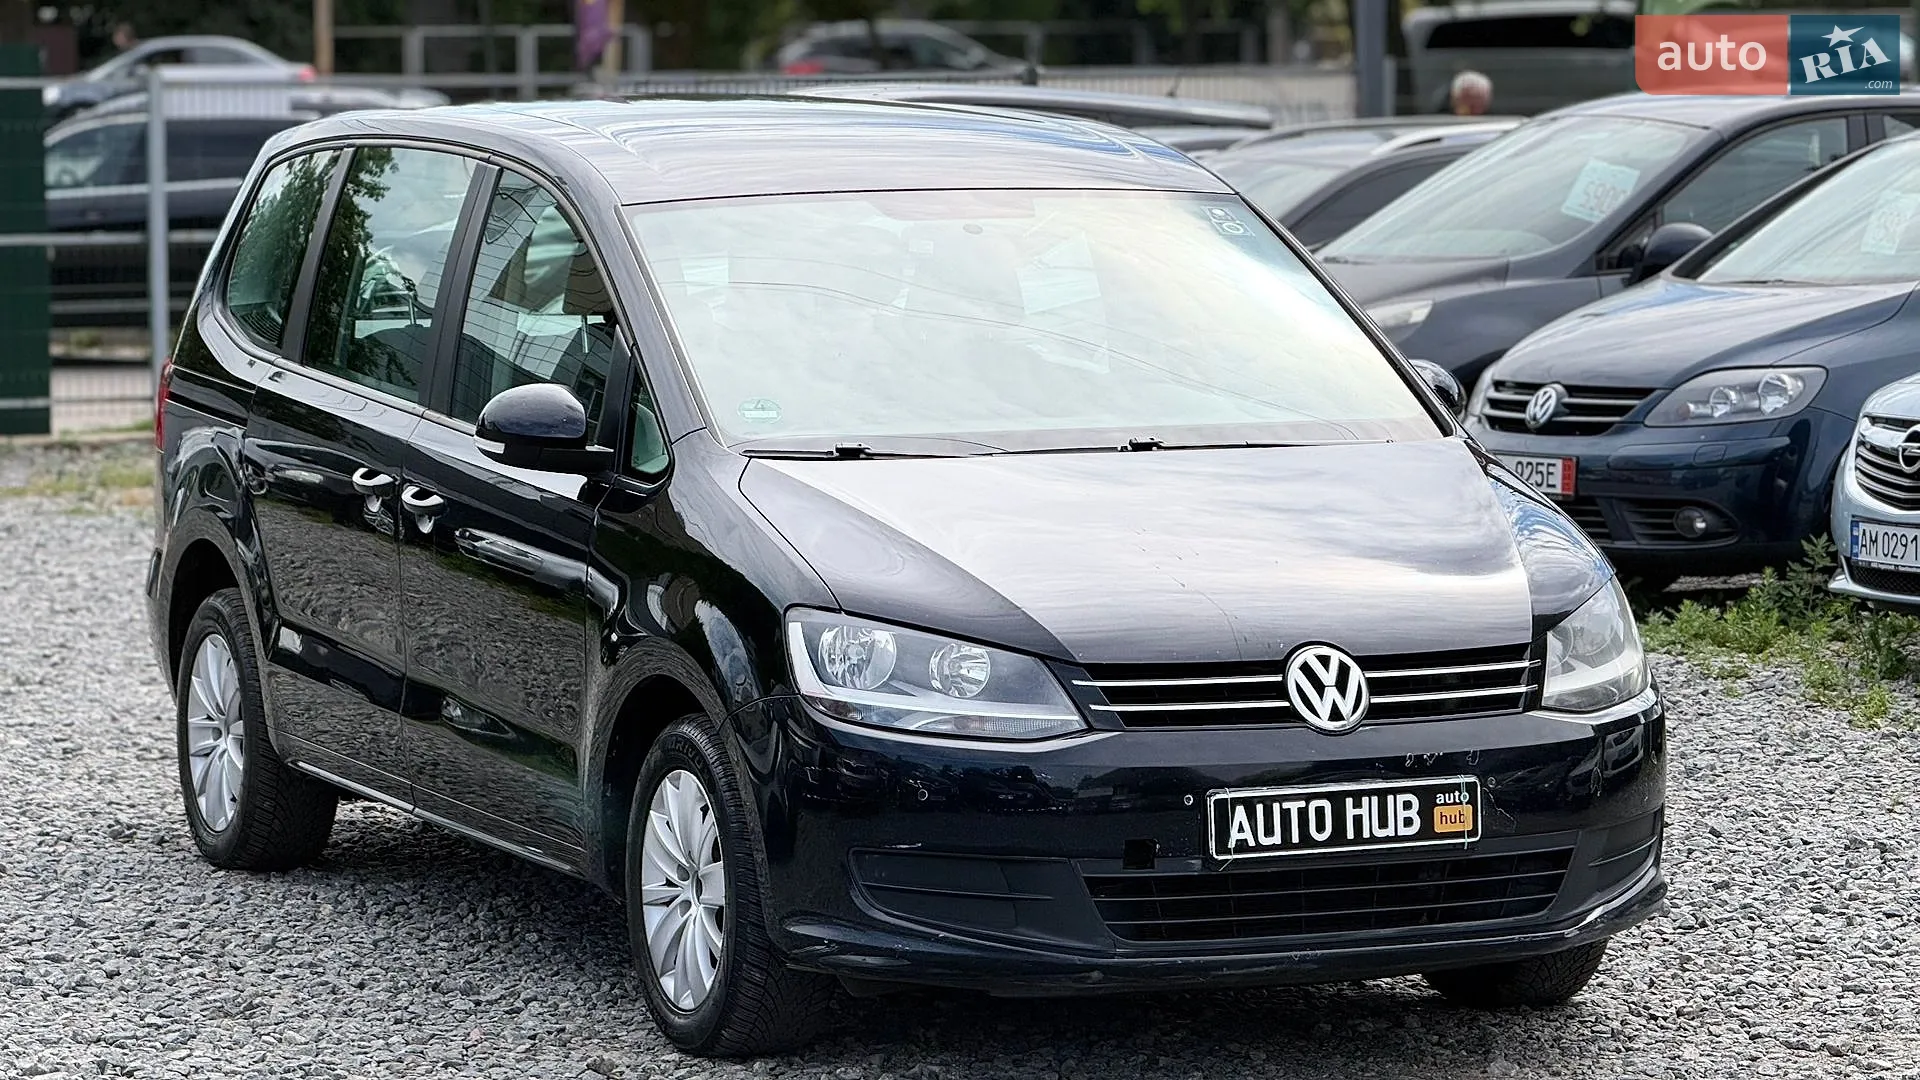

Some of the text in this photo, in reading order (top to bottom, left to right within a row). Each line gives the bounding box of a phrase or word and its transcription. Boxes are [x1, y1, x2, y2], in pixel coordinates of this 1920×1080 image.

[1860, 528, 1918, 560] AM 0291
[1436, 791, 1470, 804] auto
[1228, 794, 1421, 848] AUTO HUB
[1439, 811, 1466, 825] hub
